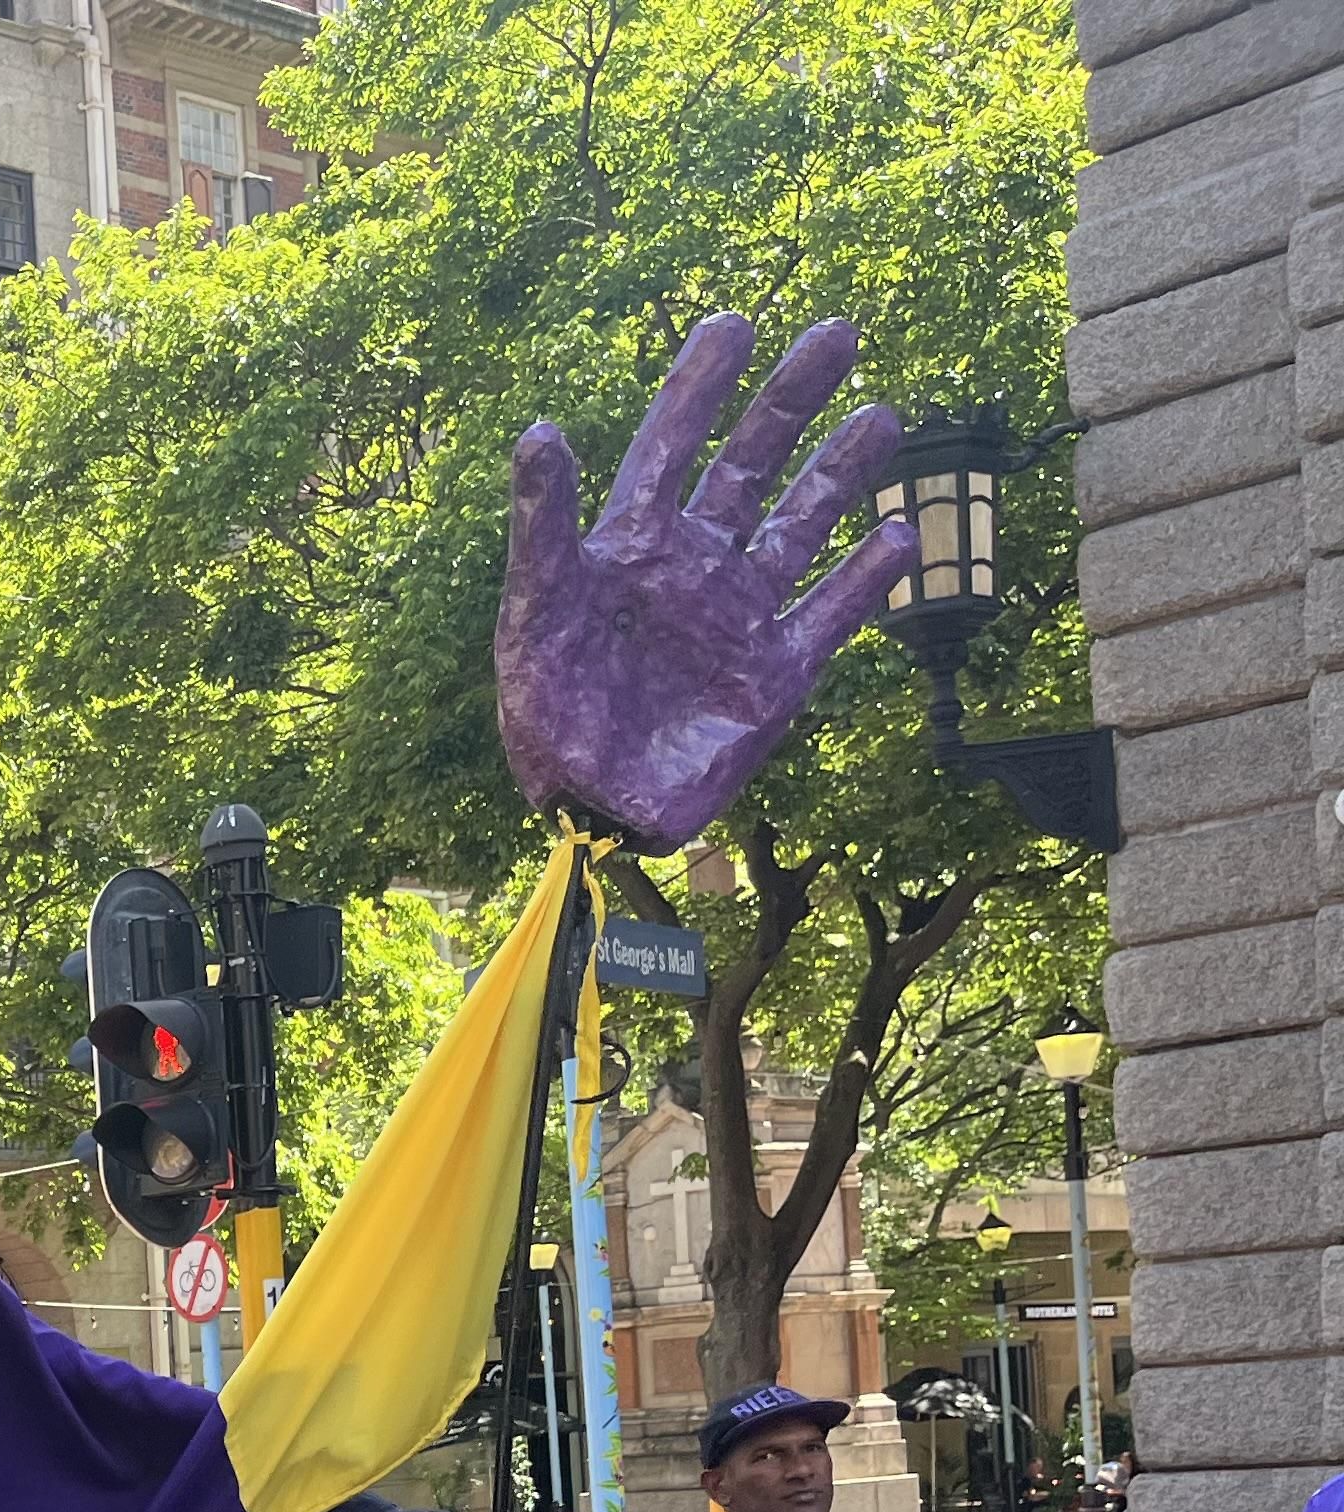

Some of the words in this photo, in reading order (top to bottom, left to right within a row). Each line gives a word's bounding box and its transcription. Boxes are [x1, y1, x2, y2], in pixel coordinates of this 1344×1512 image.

[597, 936, 611, 964] St
[613, 936, 666, 975] George's
[667, 947, 695, 976] Mall
